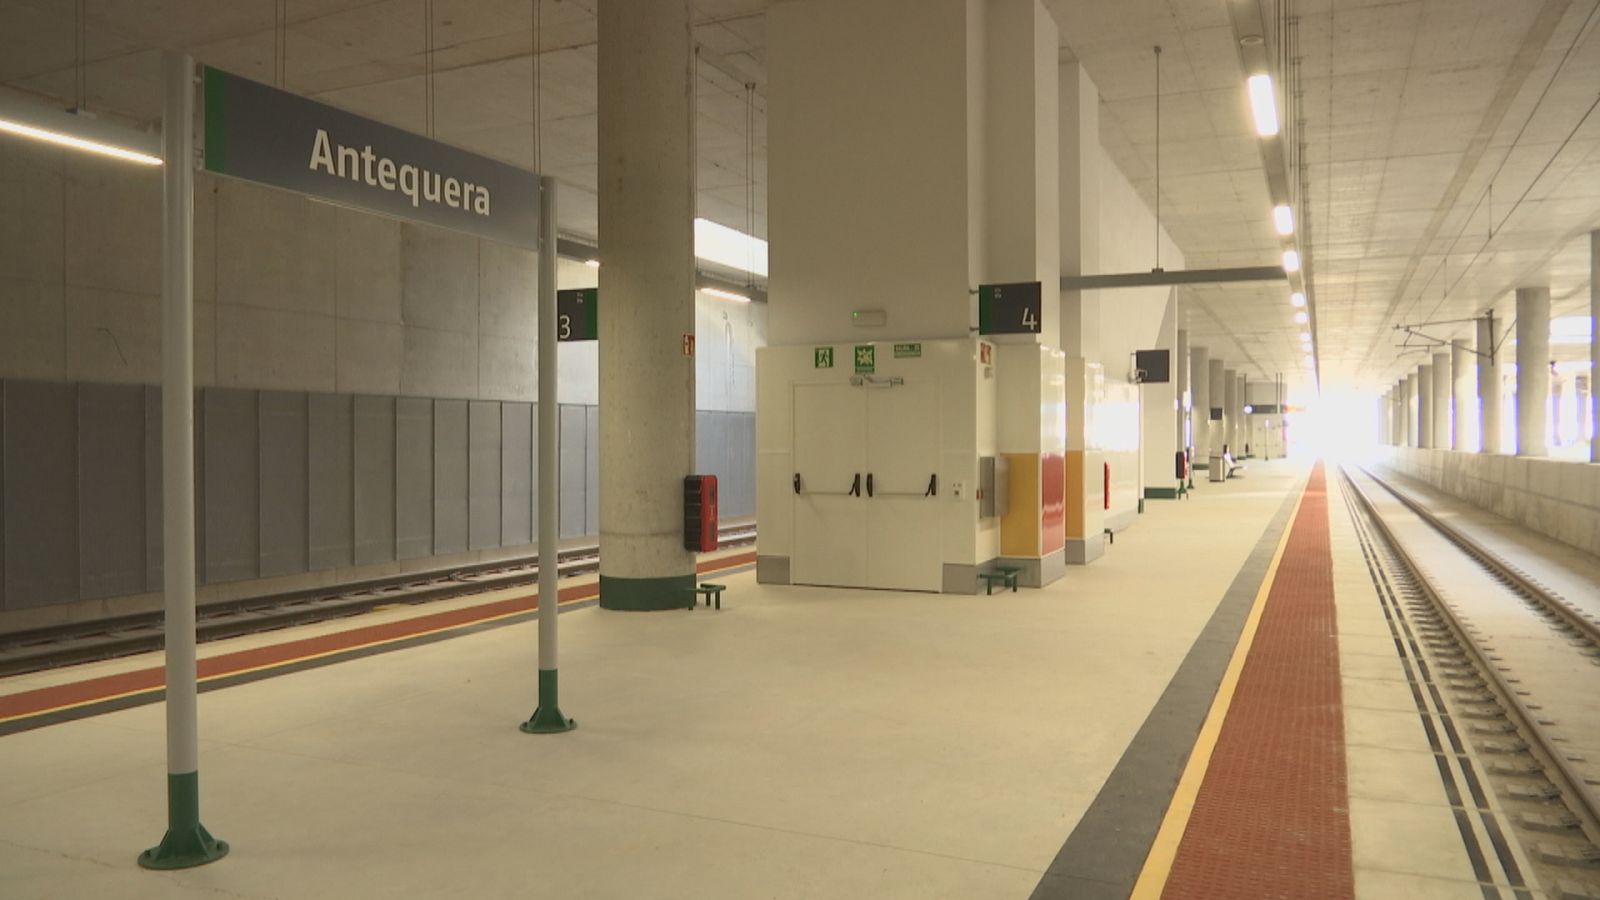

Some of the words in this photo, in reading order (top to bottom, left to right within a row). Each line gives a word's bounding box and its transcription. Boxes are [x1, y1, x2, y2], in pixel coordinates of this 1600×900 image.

[309, 129, 491, 216] Antequera
[559, 314, 571, 339] 3
[1022, 307, 1037, 330] 4
